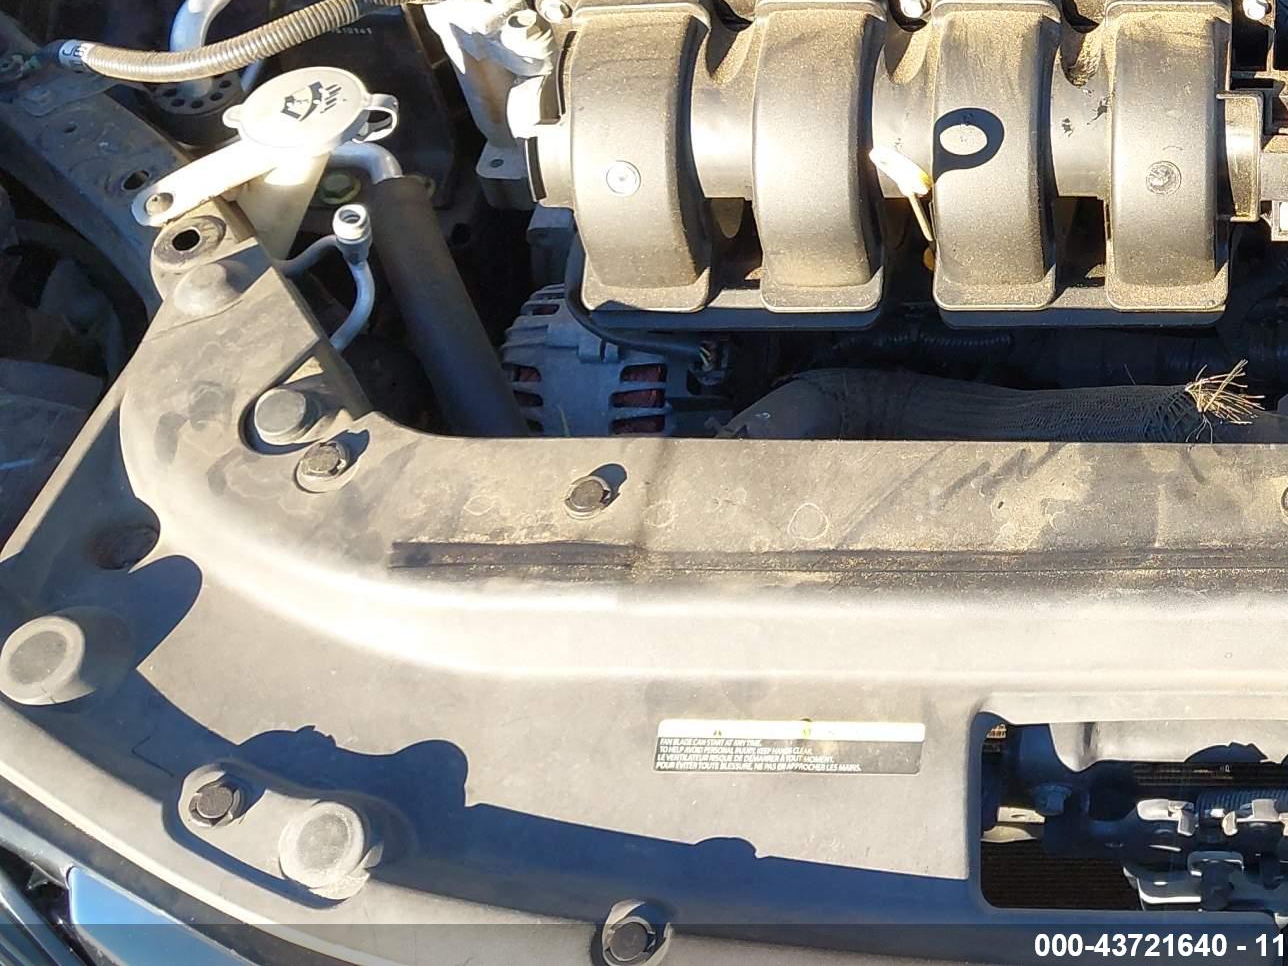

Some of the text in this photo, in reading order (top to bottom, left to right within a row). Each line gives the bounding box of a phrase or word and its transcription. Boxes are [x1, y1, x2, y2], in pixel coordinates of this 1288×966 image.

[673, 738, 692, 746] BLADE
[693, 738, 706, 746] CAN
[724, 738, 733, 746] AT
[684, 746, 704, 754] AVOID
[704, 746, 734, 754] PERSONAL
[757, 746, 772, 754] KEEP
[657, 753, 665, 761] LE
[666, 753, 709, 761] VENTILATEUR
[734, 754, 743, 762] DE
[786, 754, 803, 762] TOUT
[656, 761, 675, 769] POUR
[698, 762, 719, 770] TOUTE
[764, 762, 776, 770] PAS
[787, 762, 825, 771] APPROCHER
[826, 763, 837, 771] LES
